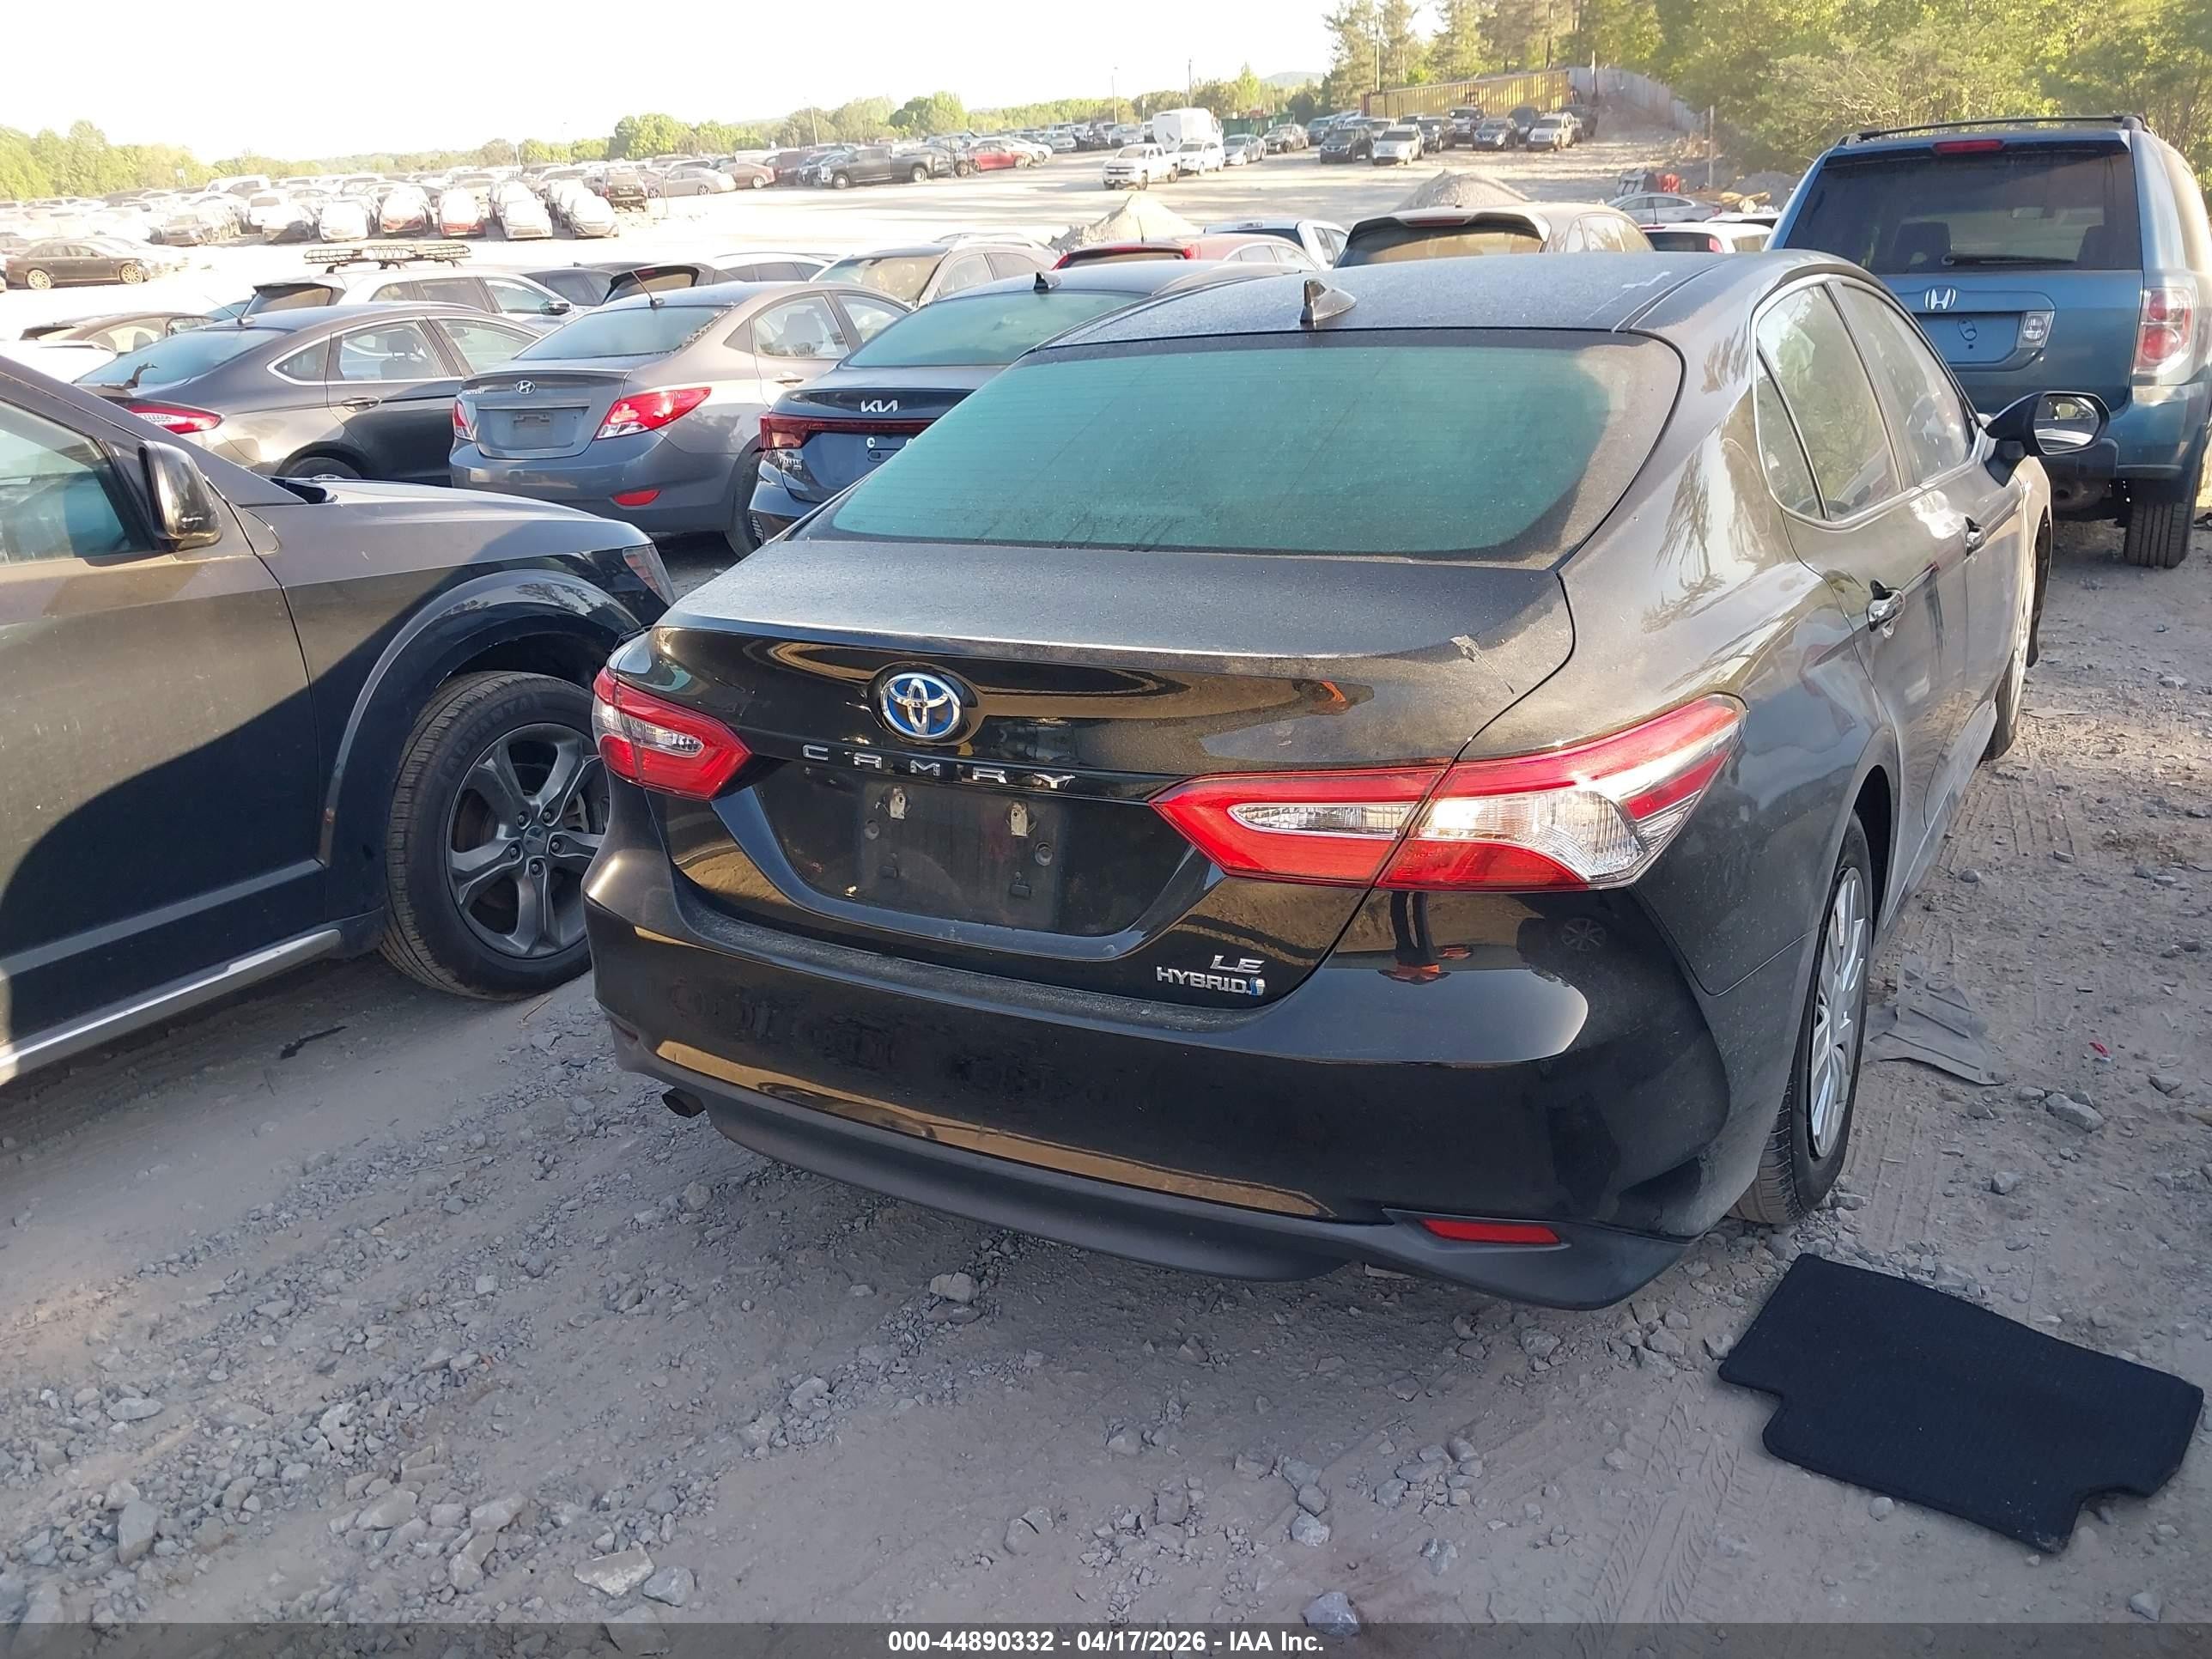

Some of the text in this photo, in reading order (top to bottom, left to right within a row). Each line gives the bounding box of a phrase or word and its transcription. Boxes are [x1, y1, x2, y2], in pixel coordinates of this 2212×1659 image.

[860, 399, 898, 413] KIA
[802, 744, 1076, 789] CAMRY
[1209, 954, 1265, 975] LE
[1156, 966, 1248, 994] HYBRID
